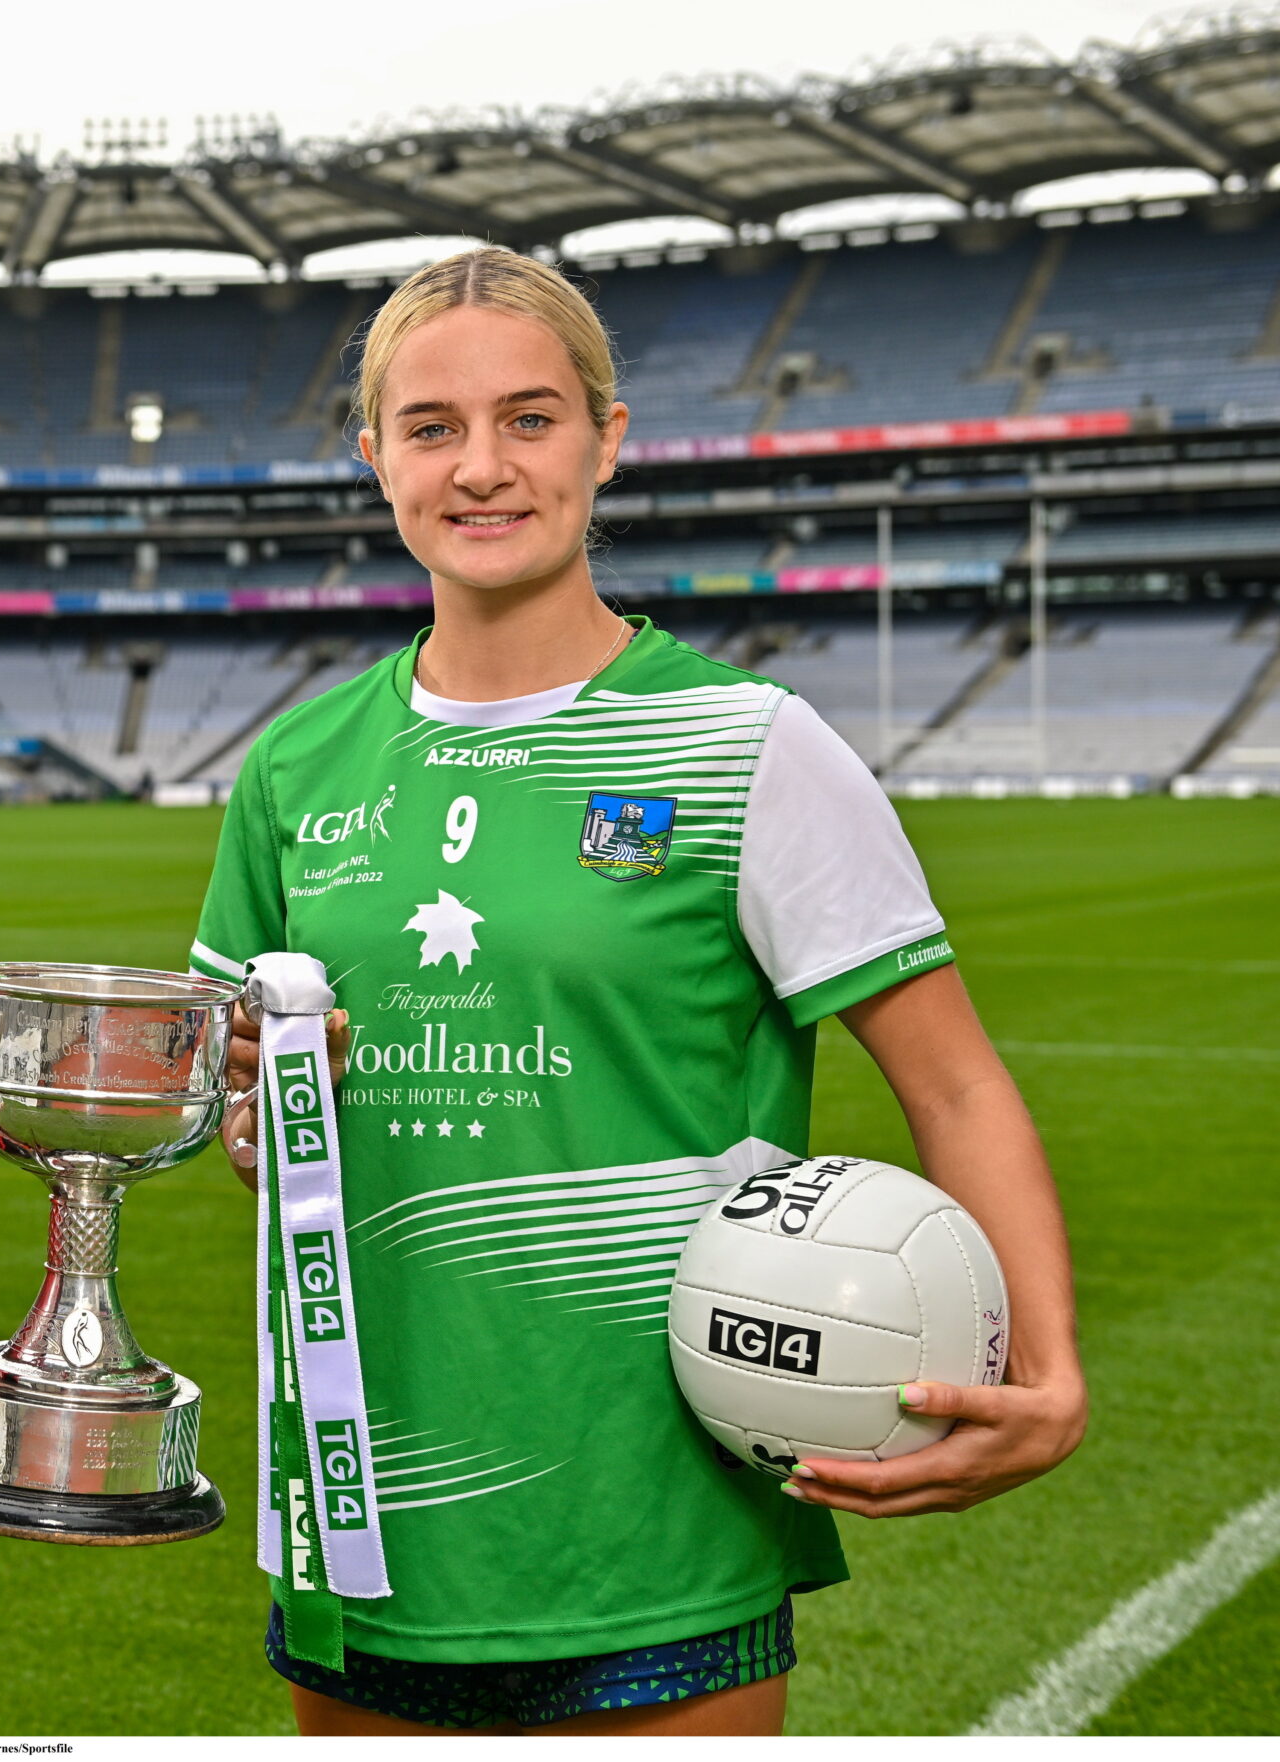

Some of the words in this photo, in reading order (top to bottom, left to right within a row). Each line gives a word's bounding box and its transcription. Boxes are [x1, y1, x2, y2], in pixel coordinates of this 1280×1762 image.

[424, 748, 531, 768] AZZURRI
[441, 795, 479, 864] 9
[289, 886, 327, 898] Division
[332, 873, 354, 888] Final
[355, 871, 384, 884] 2022
[304, 868, 326, 880] Lidl
[350, 854, 370, 867] NFL
[377, 982, 497, 1019] Fitzgeralds
[280, 1055, 323, 1159] TG4
[342, 1087, 402, 1107] HOUSE
[408, 1087, 470, 1106] HOTEL
[477, 1091, 498, 1107] &
[503, 1088, 541, 1107] SPA
[299, 1235, 341, 1336] TG4
[715, 1314, 812, 1369] TG4
[322, 1424, 364, 1525] TG4
